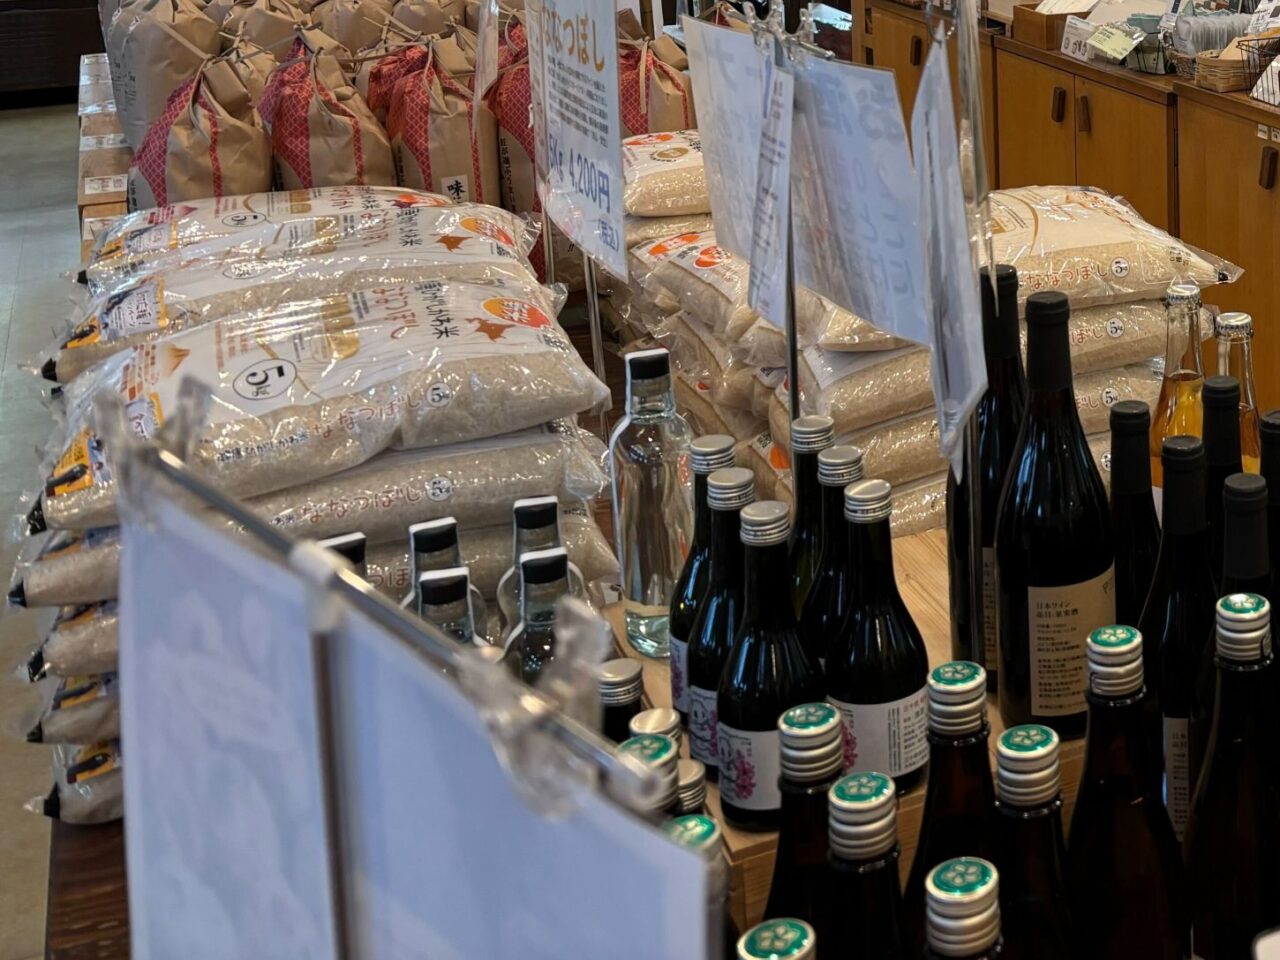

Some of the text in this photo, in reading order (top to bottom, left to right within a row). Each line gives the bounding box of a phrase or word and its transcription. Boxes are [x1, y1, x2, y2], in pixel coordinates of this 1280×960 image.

[1026, 263, 1108, 291] ななつぼし
[312, 392, 421, 440] ななつぼし
[302, 484, 422, 525] ななつぼし
